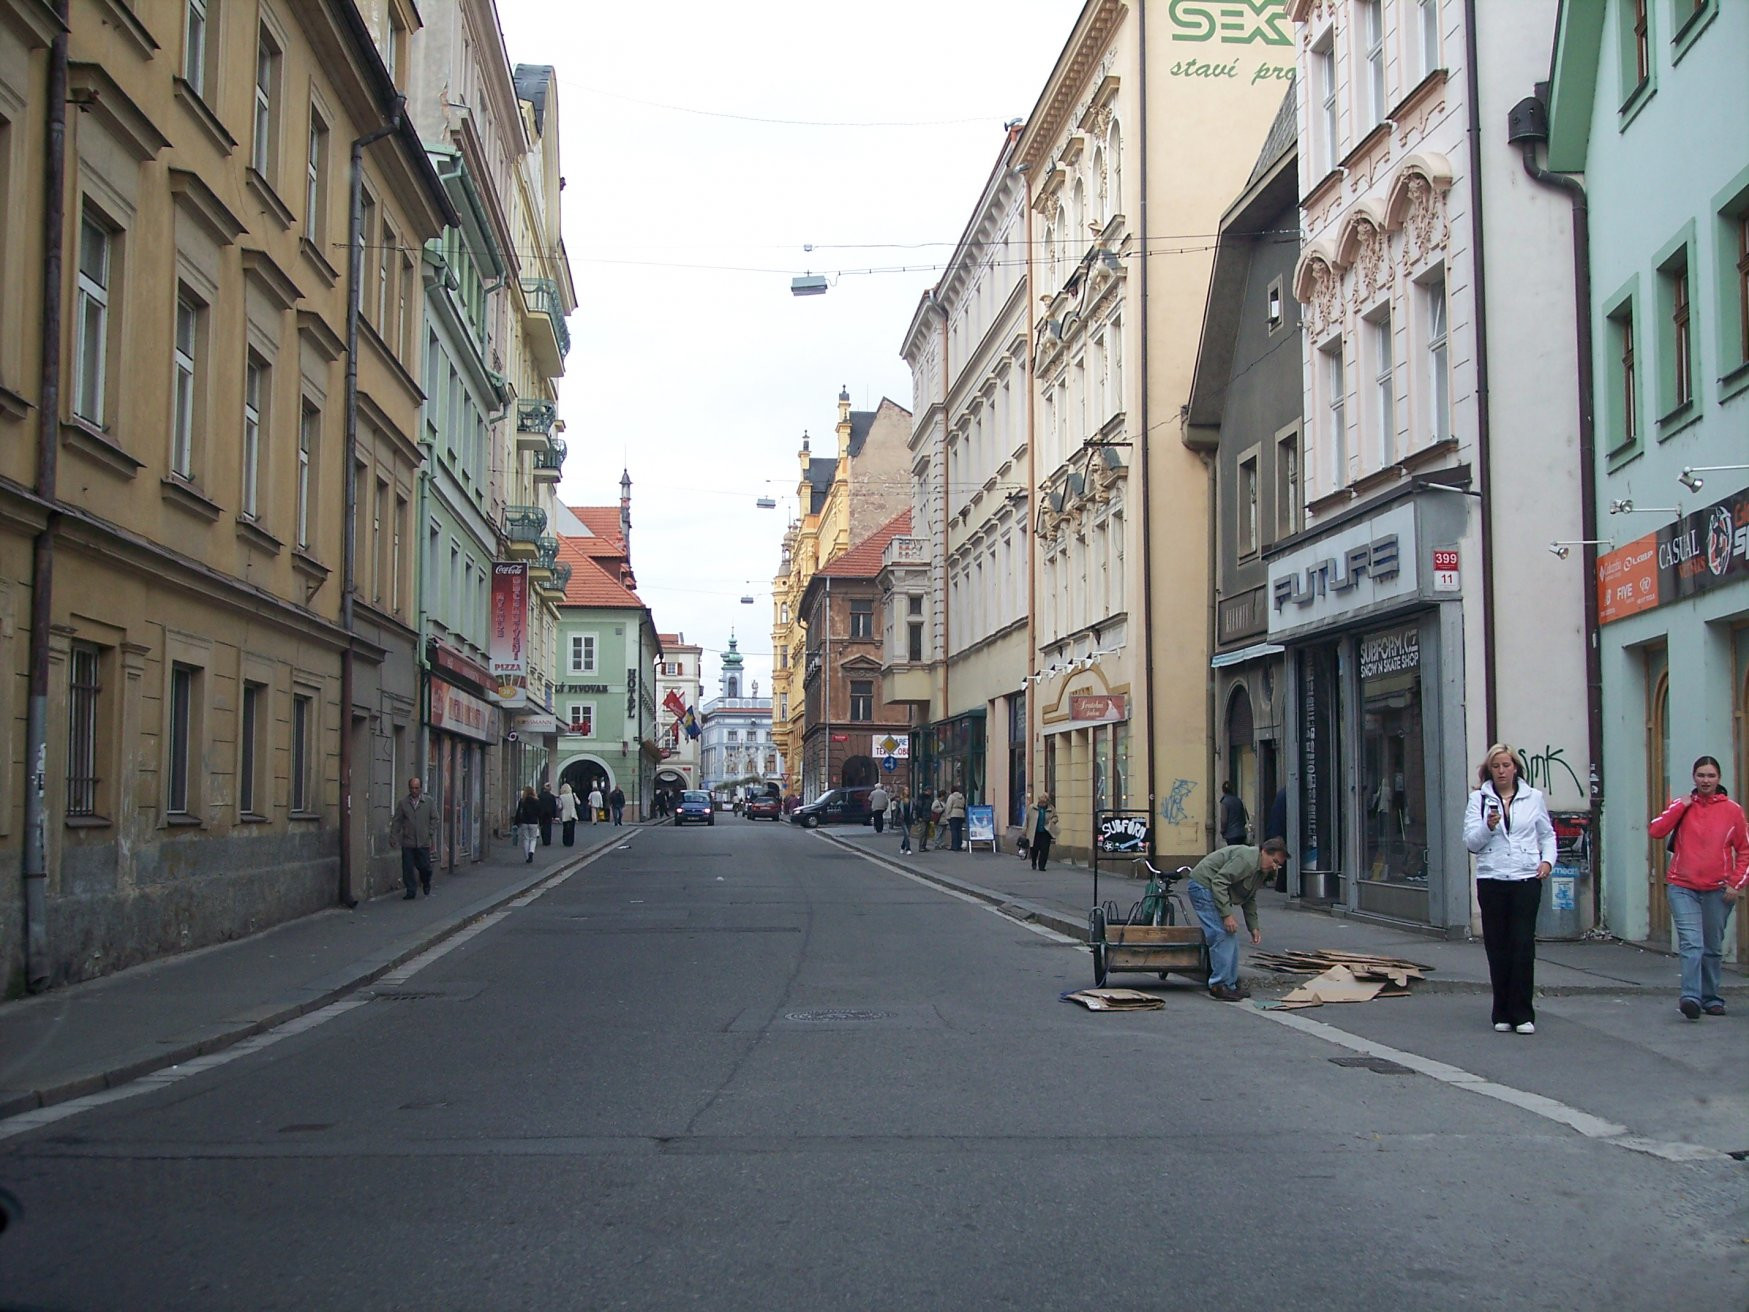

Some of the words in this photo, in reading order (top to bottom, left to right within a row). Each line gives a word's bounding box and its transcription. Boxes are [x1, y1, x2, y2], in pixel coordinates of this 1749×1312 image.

[1170, 58, 1239, 78] staví
[1435, 553, 1457, 564] 399
[1658, 529, 1700, 570] CASUAL
[1273, 533, 1399, 611] FUTURE
[1441, 574, 1453, 584] 11
[1616, 583, 1633, 600] FIVE
[1360, 629, 1418, 664] SUBFORM.CZ
[494, 663, 521, 671] PIZZA
[1401, 652, 1419, 668] SHOP
[555, 682, 565, 694] LÝ
[568, 684, 608, 694] PIVOVAR
[627, 668, 637, 718] HOTEL
[1101, 819, 1147, 839] SUBFORM
